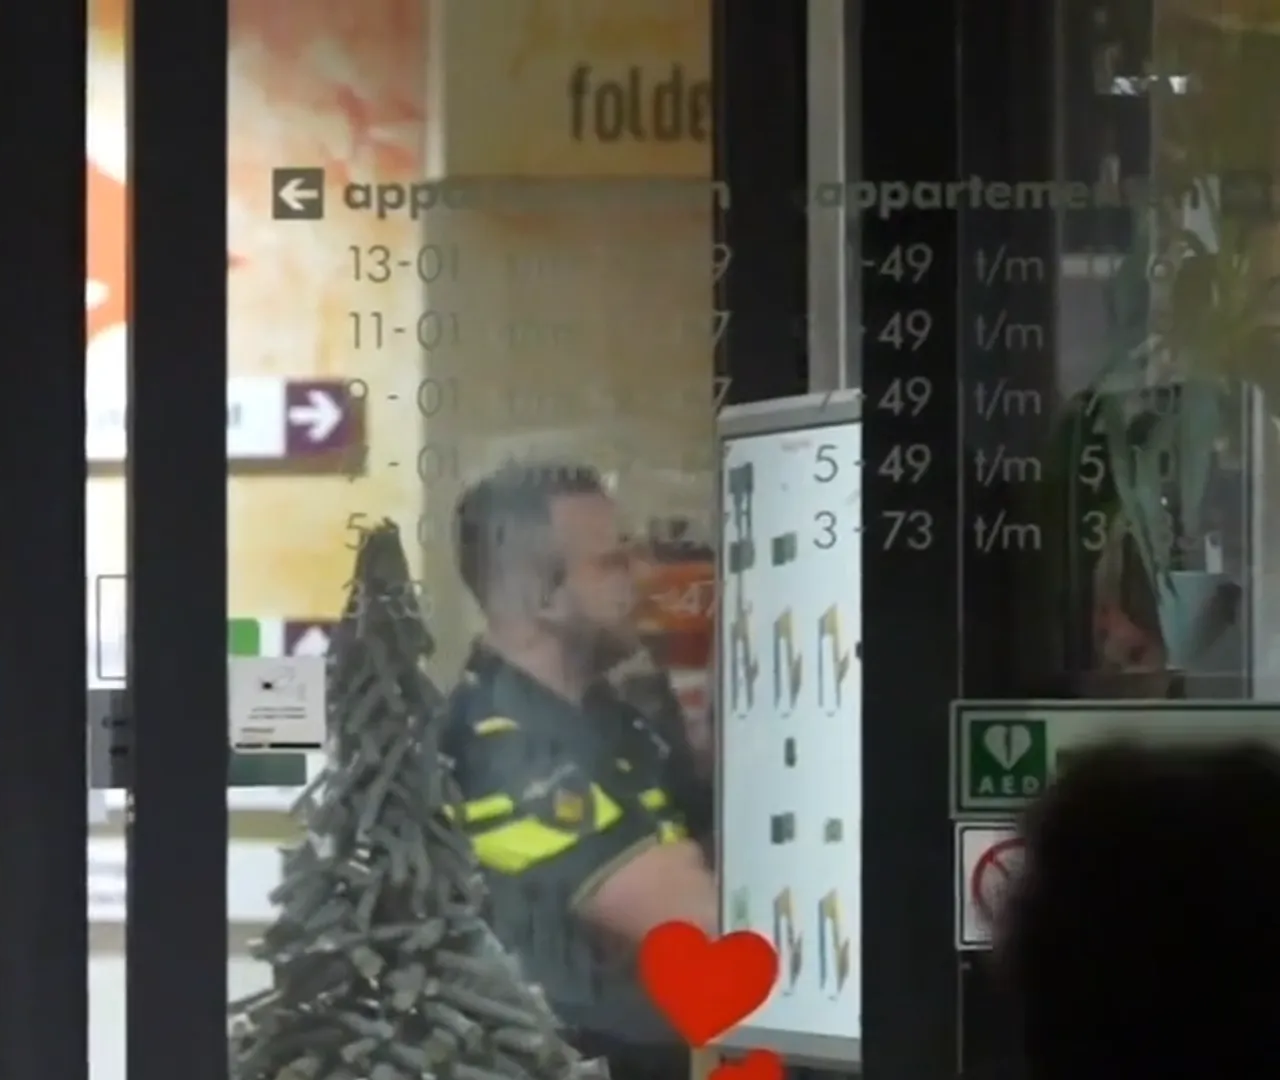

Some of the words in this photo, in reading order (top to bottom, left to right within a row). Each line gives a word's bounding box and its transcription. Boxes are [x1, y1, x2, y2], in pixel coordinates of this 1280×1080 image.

[568, 62, 713, 144] folde
[975, 244, 1044, 286] t/m
[974, 309, 1044, 351] t/m
[974, 379, 1042, 421] t/m
[974, 444, 1042, 487] t/m
[973, 509, 1042, 553] t/m
